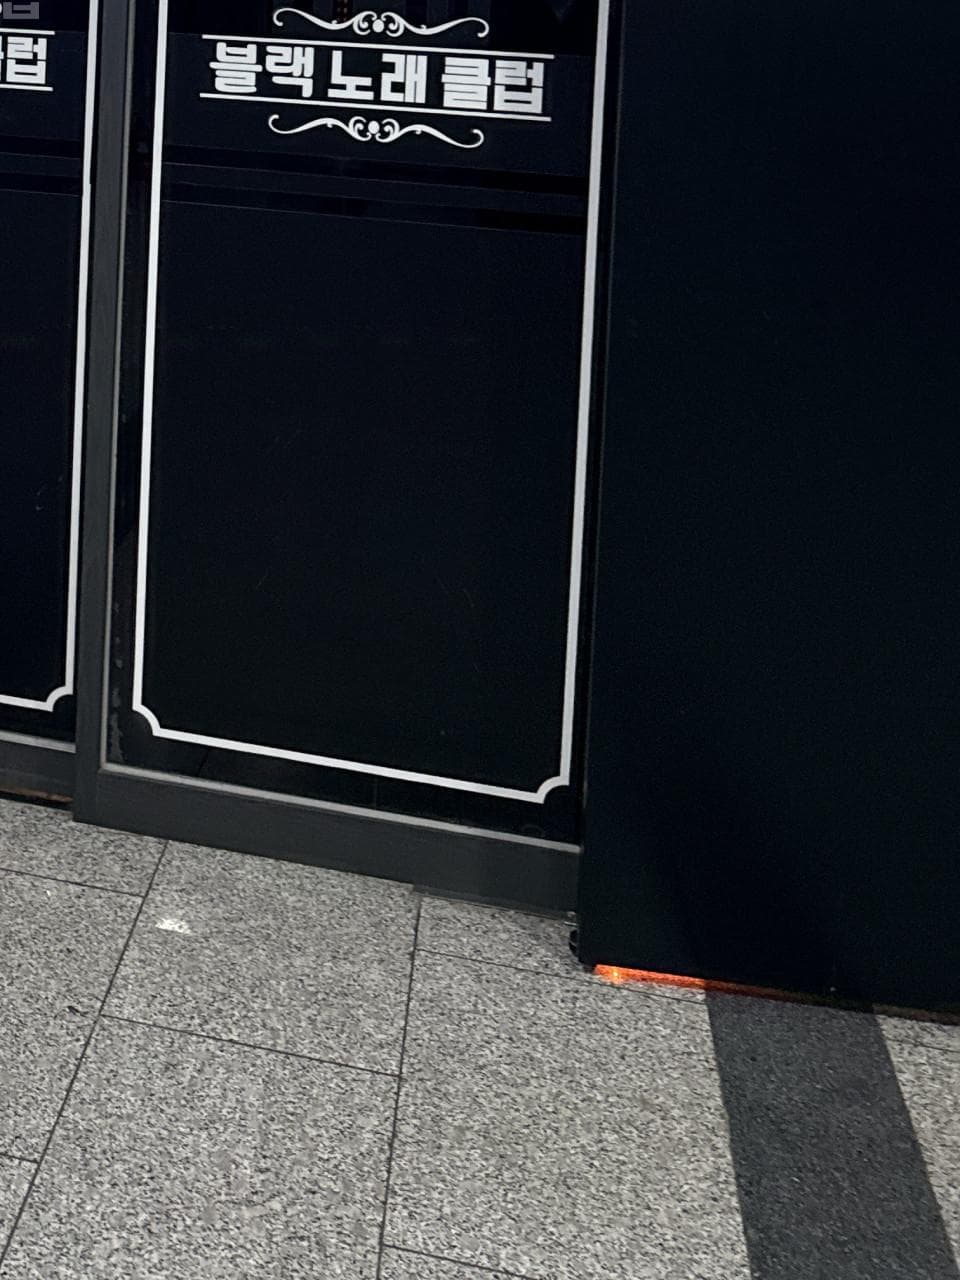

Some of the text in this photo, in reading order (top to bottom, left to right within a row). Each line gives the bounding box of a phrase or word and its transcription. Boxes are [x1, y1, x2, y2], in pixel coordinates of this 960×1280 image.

[209, 42, 544, 113] 블랙 노래 클럽
